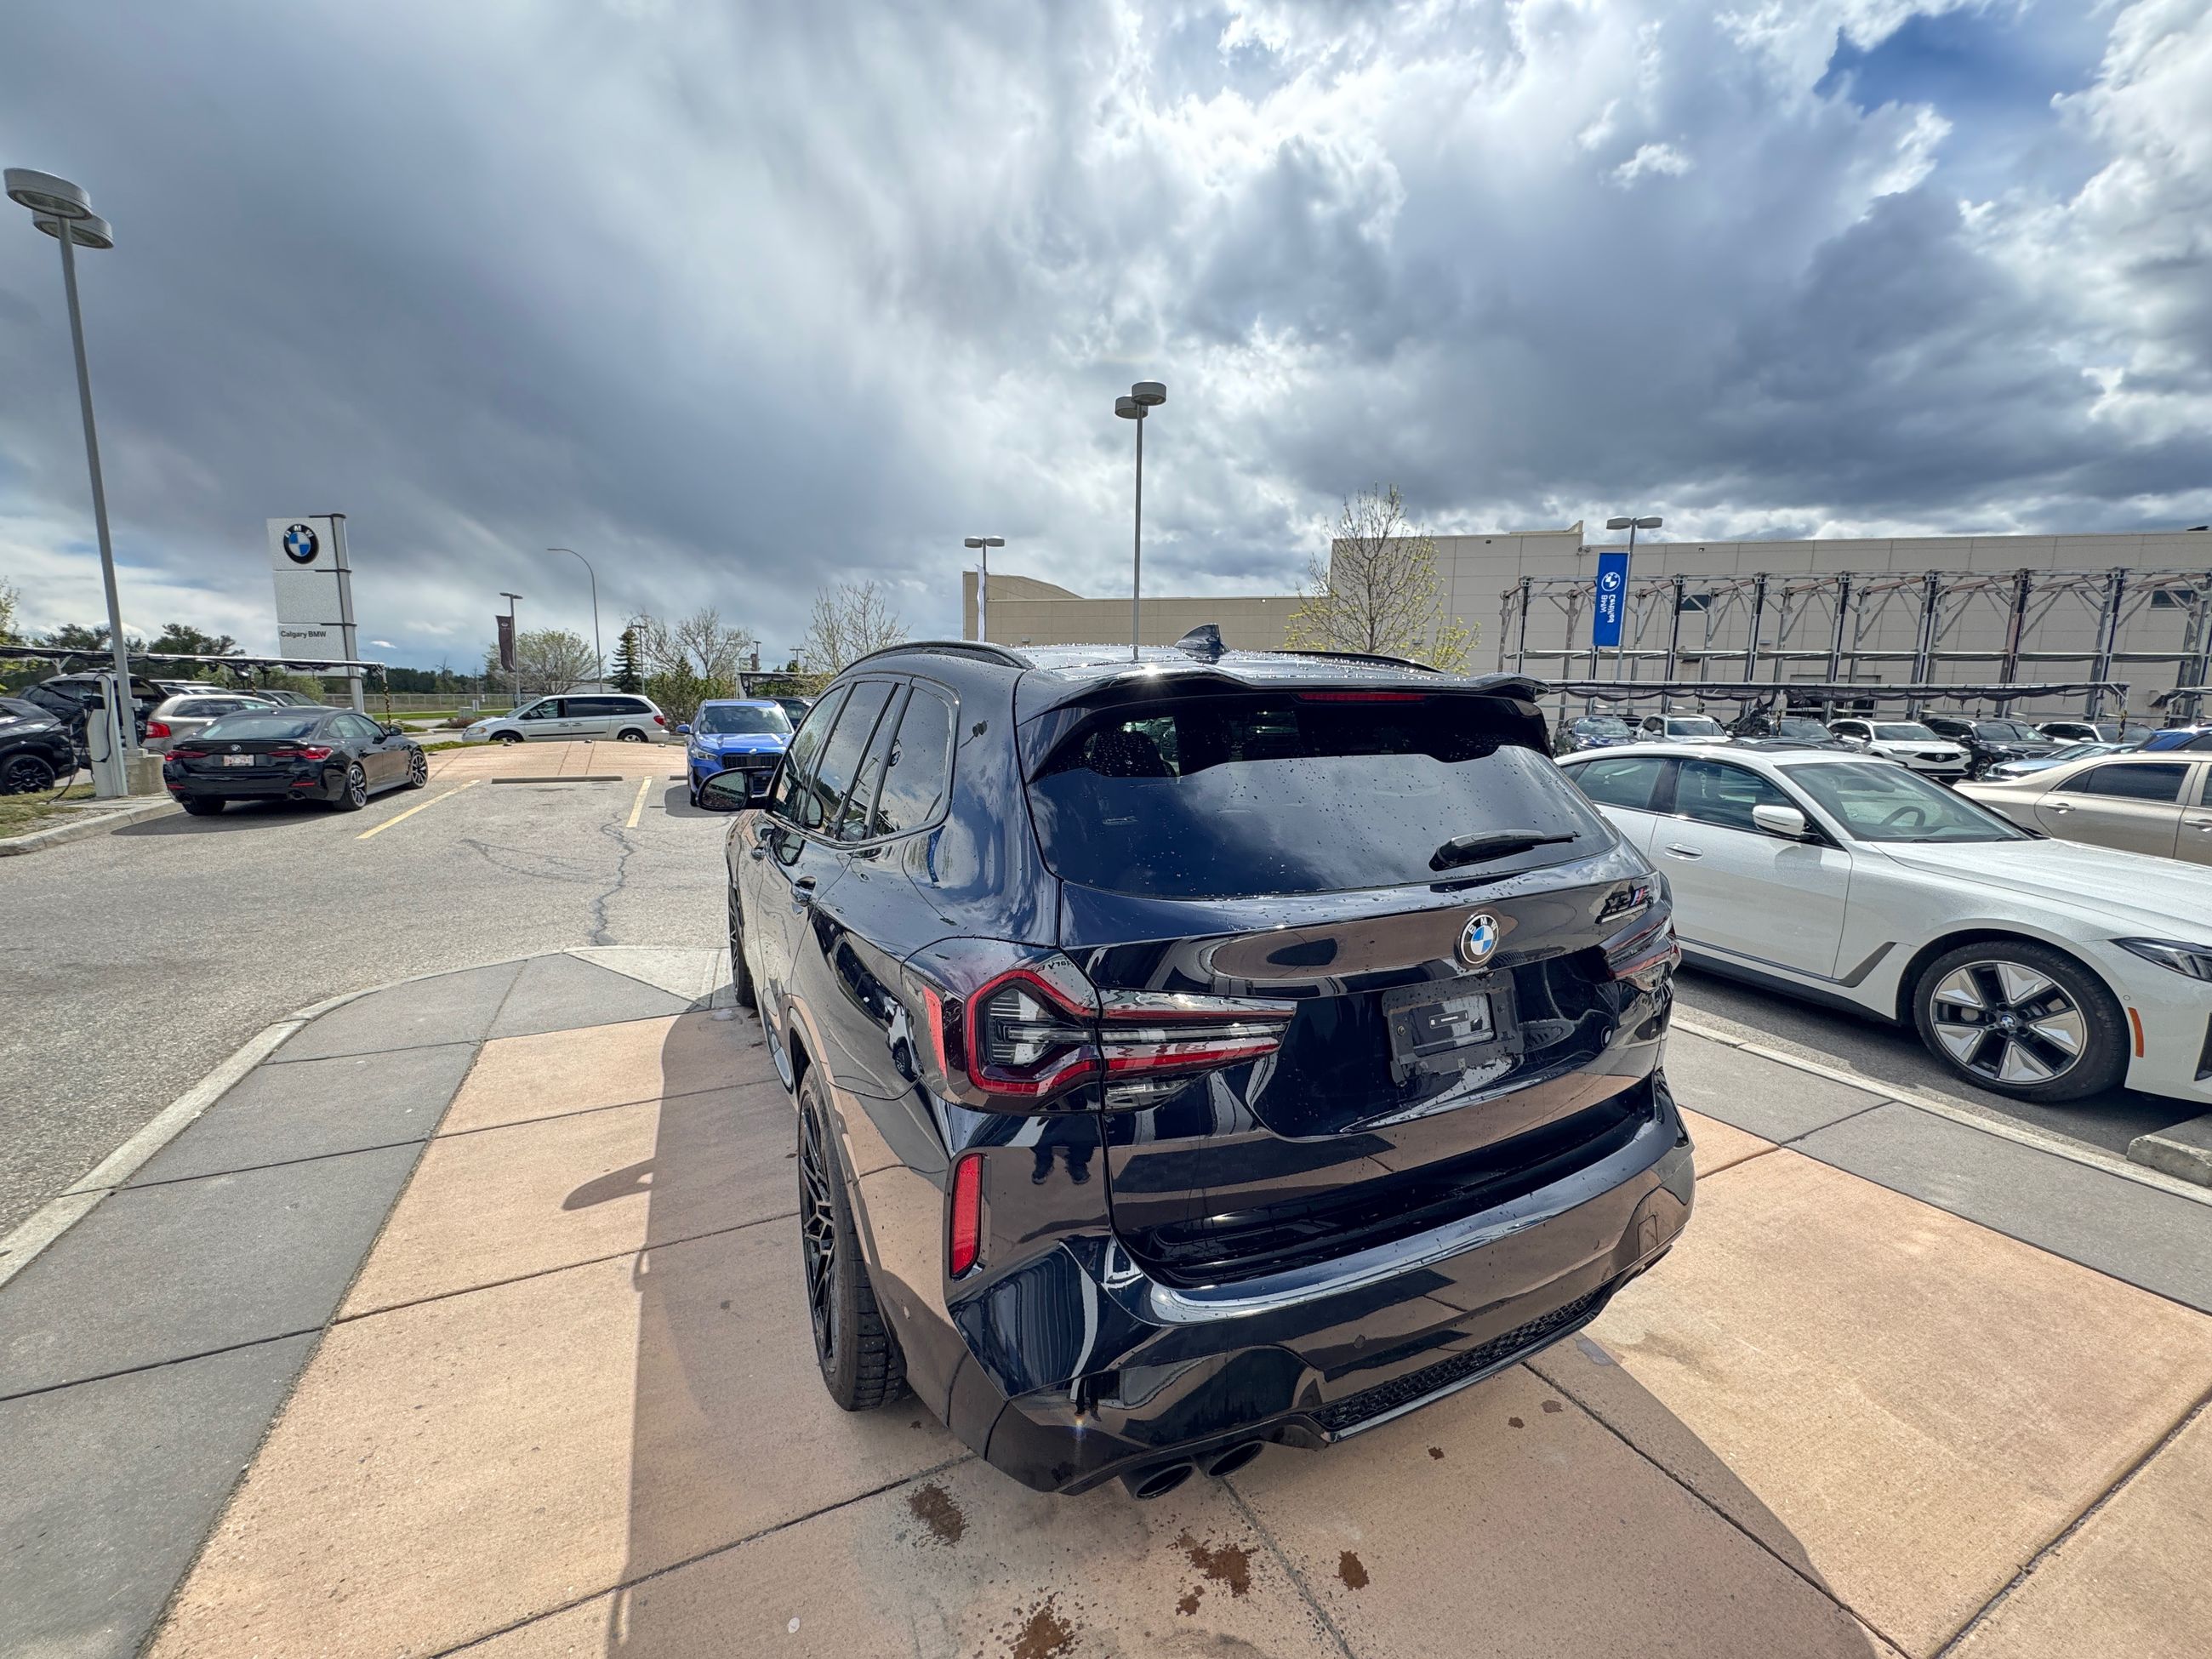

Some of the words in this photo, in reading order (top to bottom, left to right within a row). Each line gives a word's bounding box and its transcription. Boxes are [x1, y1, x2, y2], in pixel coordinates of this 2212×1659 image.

[284, 524, 315, 539] BMW
[280, 630, 307, 639] Calgary
[1468, 916, 1498, 935] BMW
